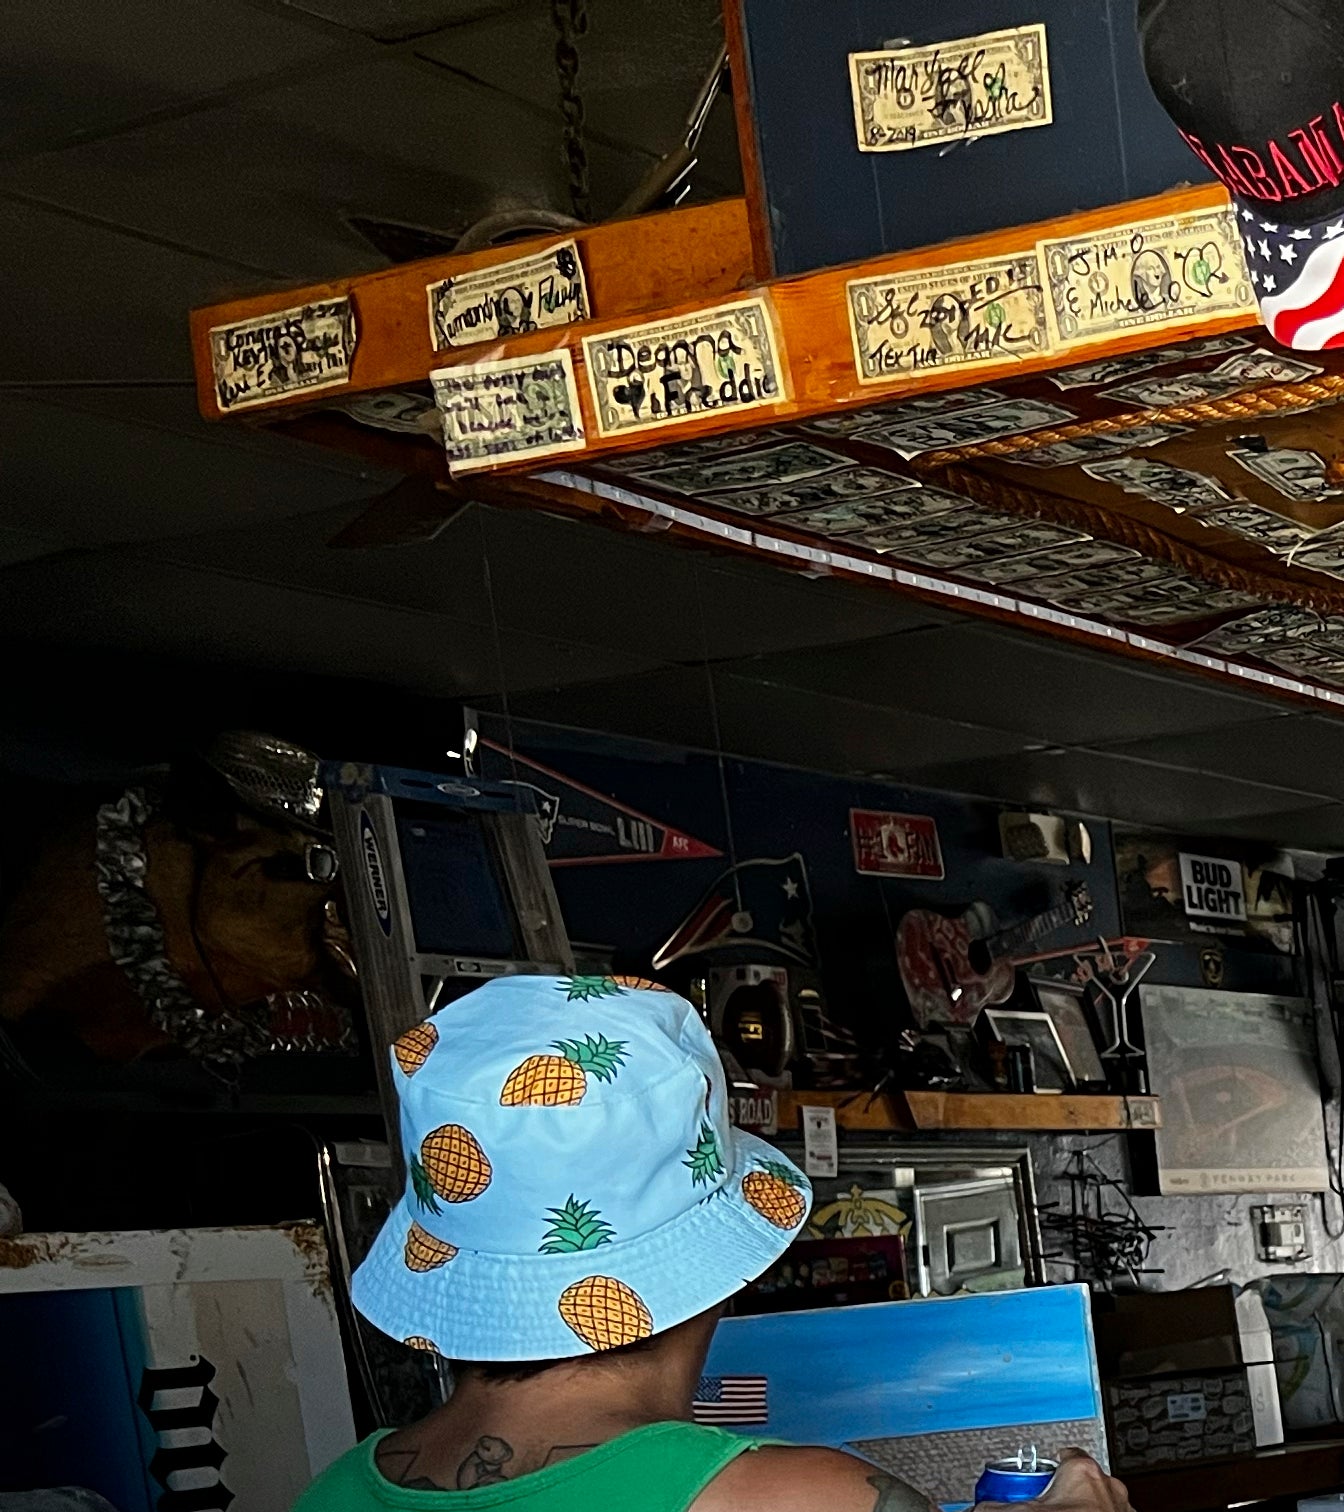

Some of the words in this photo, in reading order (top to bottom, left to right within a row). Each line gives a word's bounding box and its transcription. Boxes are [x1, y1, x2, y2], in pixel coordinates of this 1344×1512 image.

[606, 328, 742, 378] Deanna
[364, 835, 388, 913] WERNER
[1190, 859, 1233, 888] BUD
[1185, 885, 1242, 916] LIGHT
